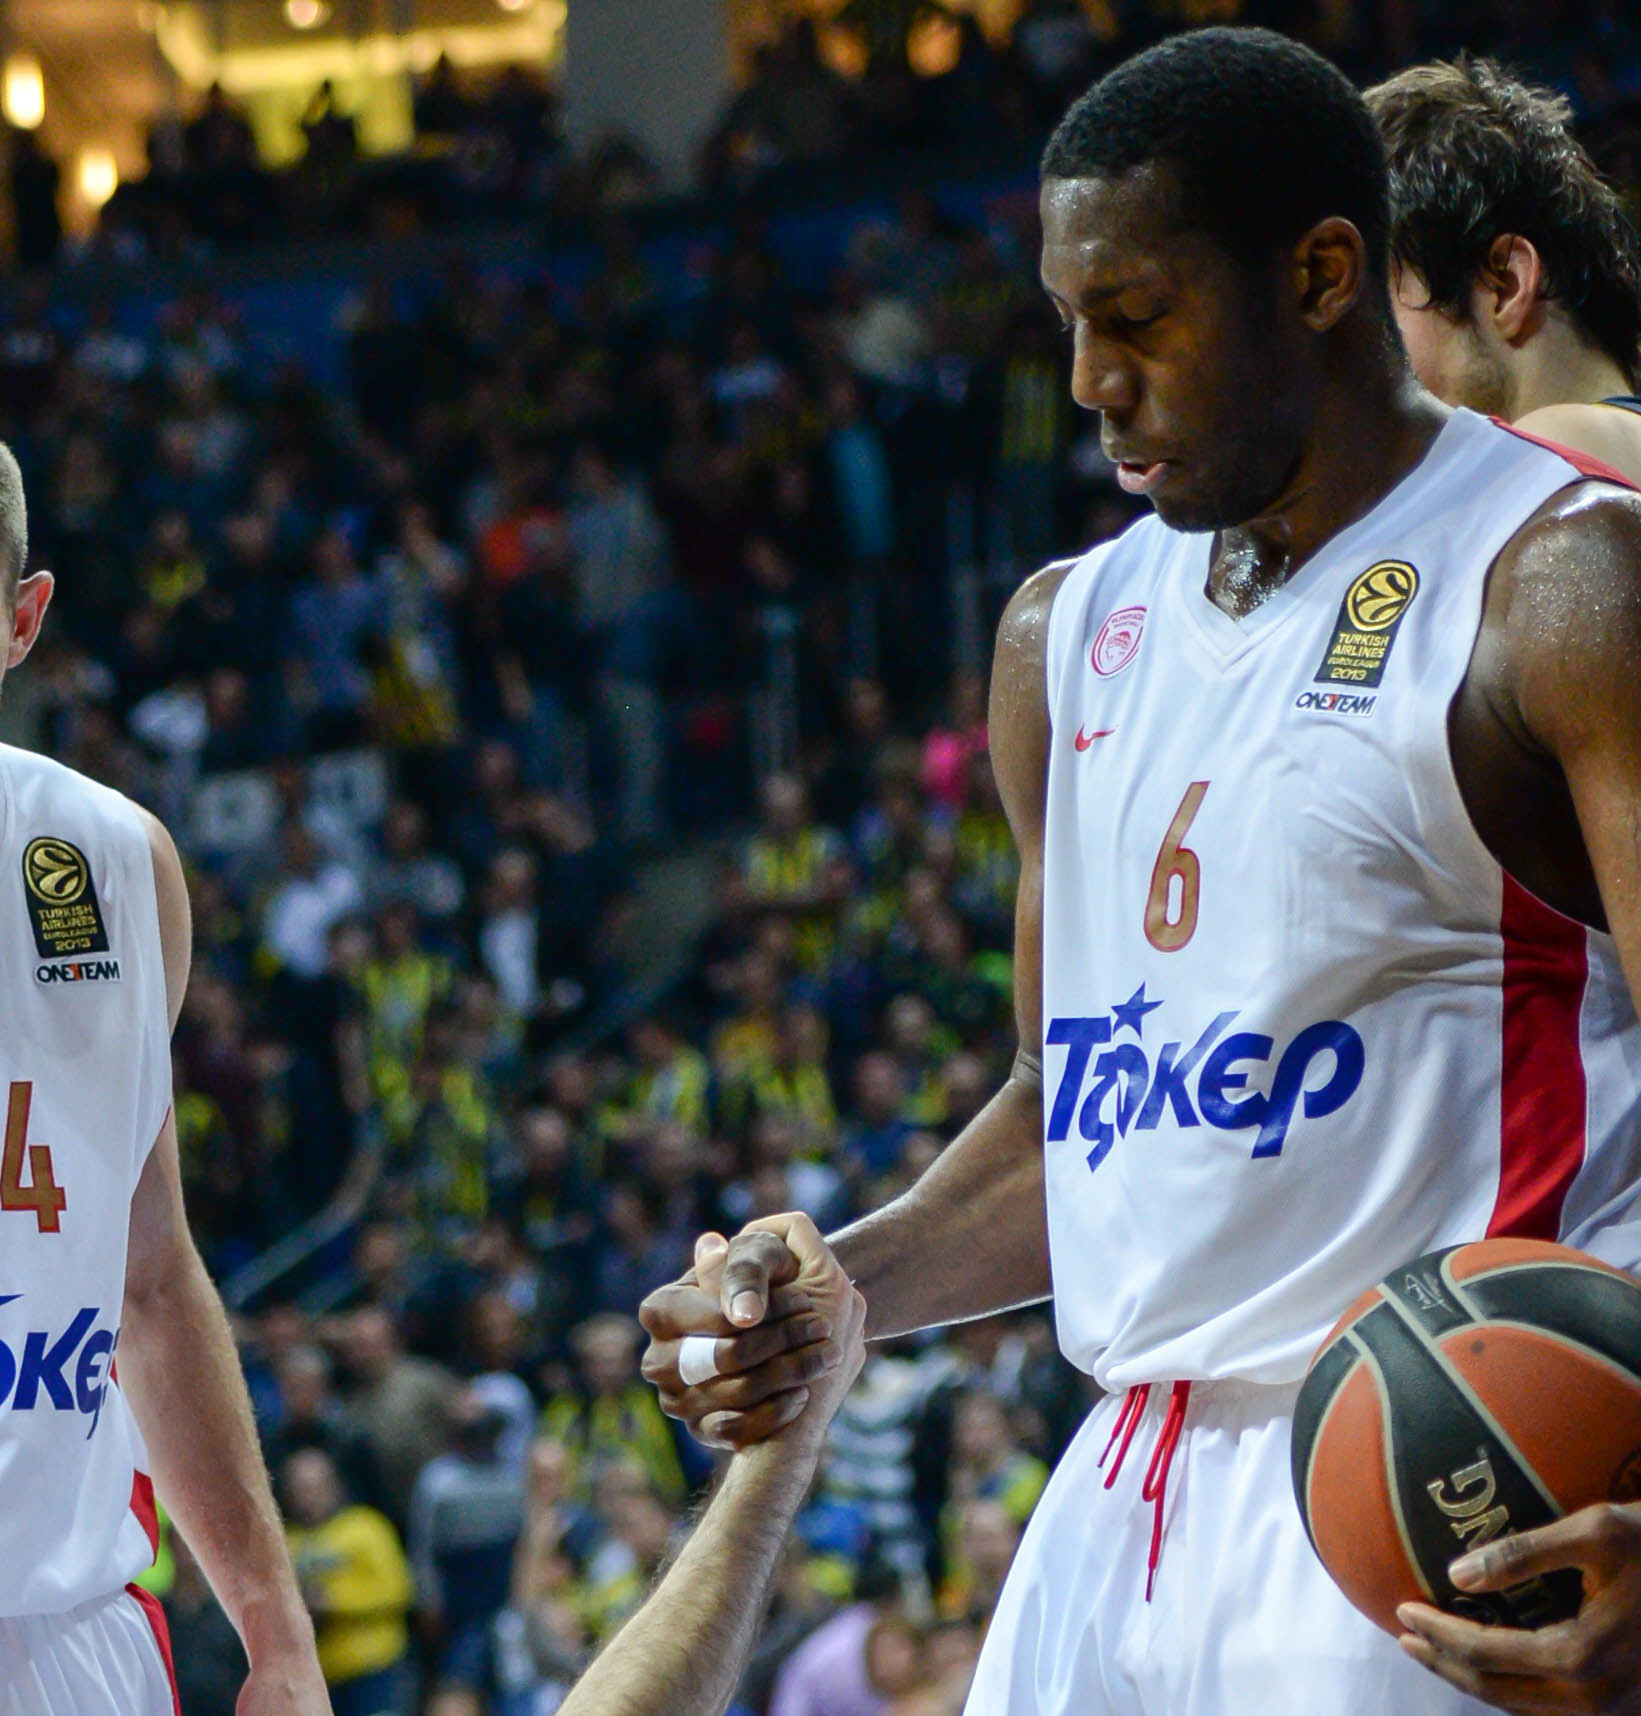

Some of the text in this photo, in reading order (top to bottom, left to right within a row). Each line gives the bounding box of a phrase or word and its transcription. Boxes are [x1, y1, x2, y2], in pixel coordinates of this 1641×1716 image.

[1339, 632, 1390, 647] TURKISH
[1332, 645, 1386, 658] AIRLINES
[1330, 667, 1368, 681] 2013
[1143, 780, 1210, 953] 6
[38, 903, 94, 920] TURKISH
[55, 937, 92, 951] 2013
